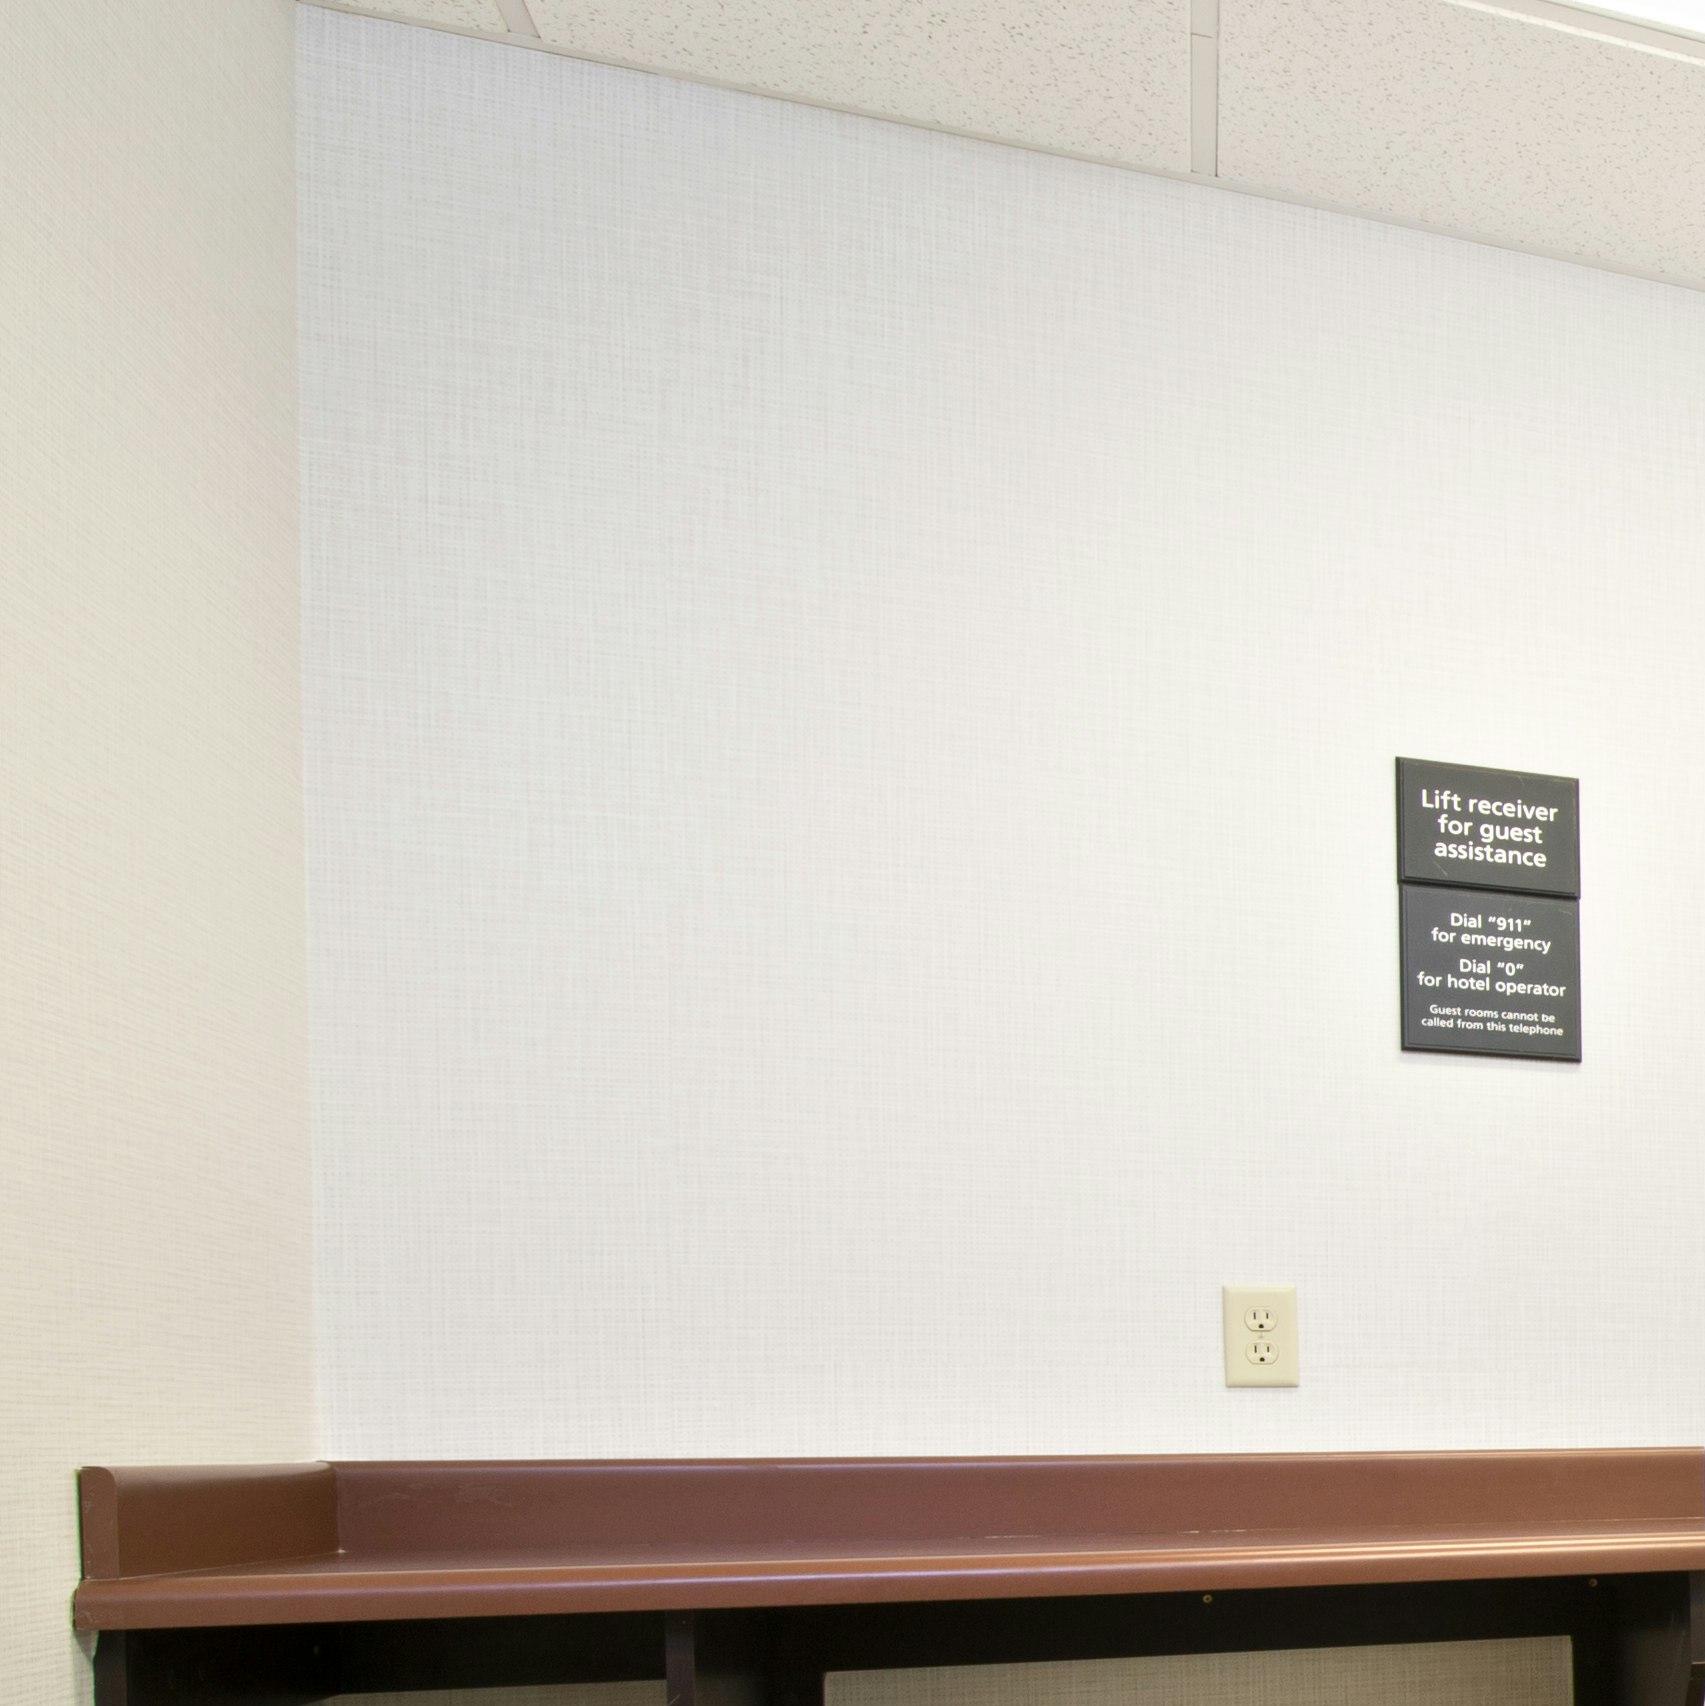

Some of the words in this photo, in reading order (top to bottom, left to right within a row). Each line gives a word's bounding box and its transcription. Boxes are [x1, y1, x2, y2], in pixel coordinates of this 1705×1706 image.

[1422, 789, 1462, 811] Lift
[1468, 799, 1559, 822] receiver
[1438, 814, 1473, 836] for
[1480, 823, 1543, 844] guest
[1434, 841, 1547, 868] assistance
[1451, 912, 1482, 928] Dial
[1431, 927, 1456, 943] for
[1461, 932, 1551, 954] emergency
[1460, 958, 1490, 974] Dial
[1417, 971, 1442, 987] for
[1448, 974, 1490, 991] hotel
[1495, 981, 1566, 997] operator
[1430, 1004, 1462, 1016] Guest
[1464, 1008, 1498, 1018] rooms
[1501, 1011, 1538, 1022] cannot
[1542, 1014, 1555, 1023] be
[1421, 1018, 1454, 1028] called
[1457, 1019, 1483, 1030] from
[1486, 1022, 1506, 1032] this
[1509, 1023, 1564, 1036] telephone
